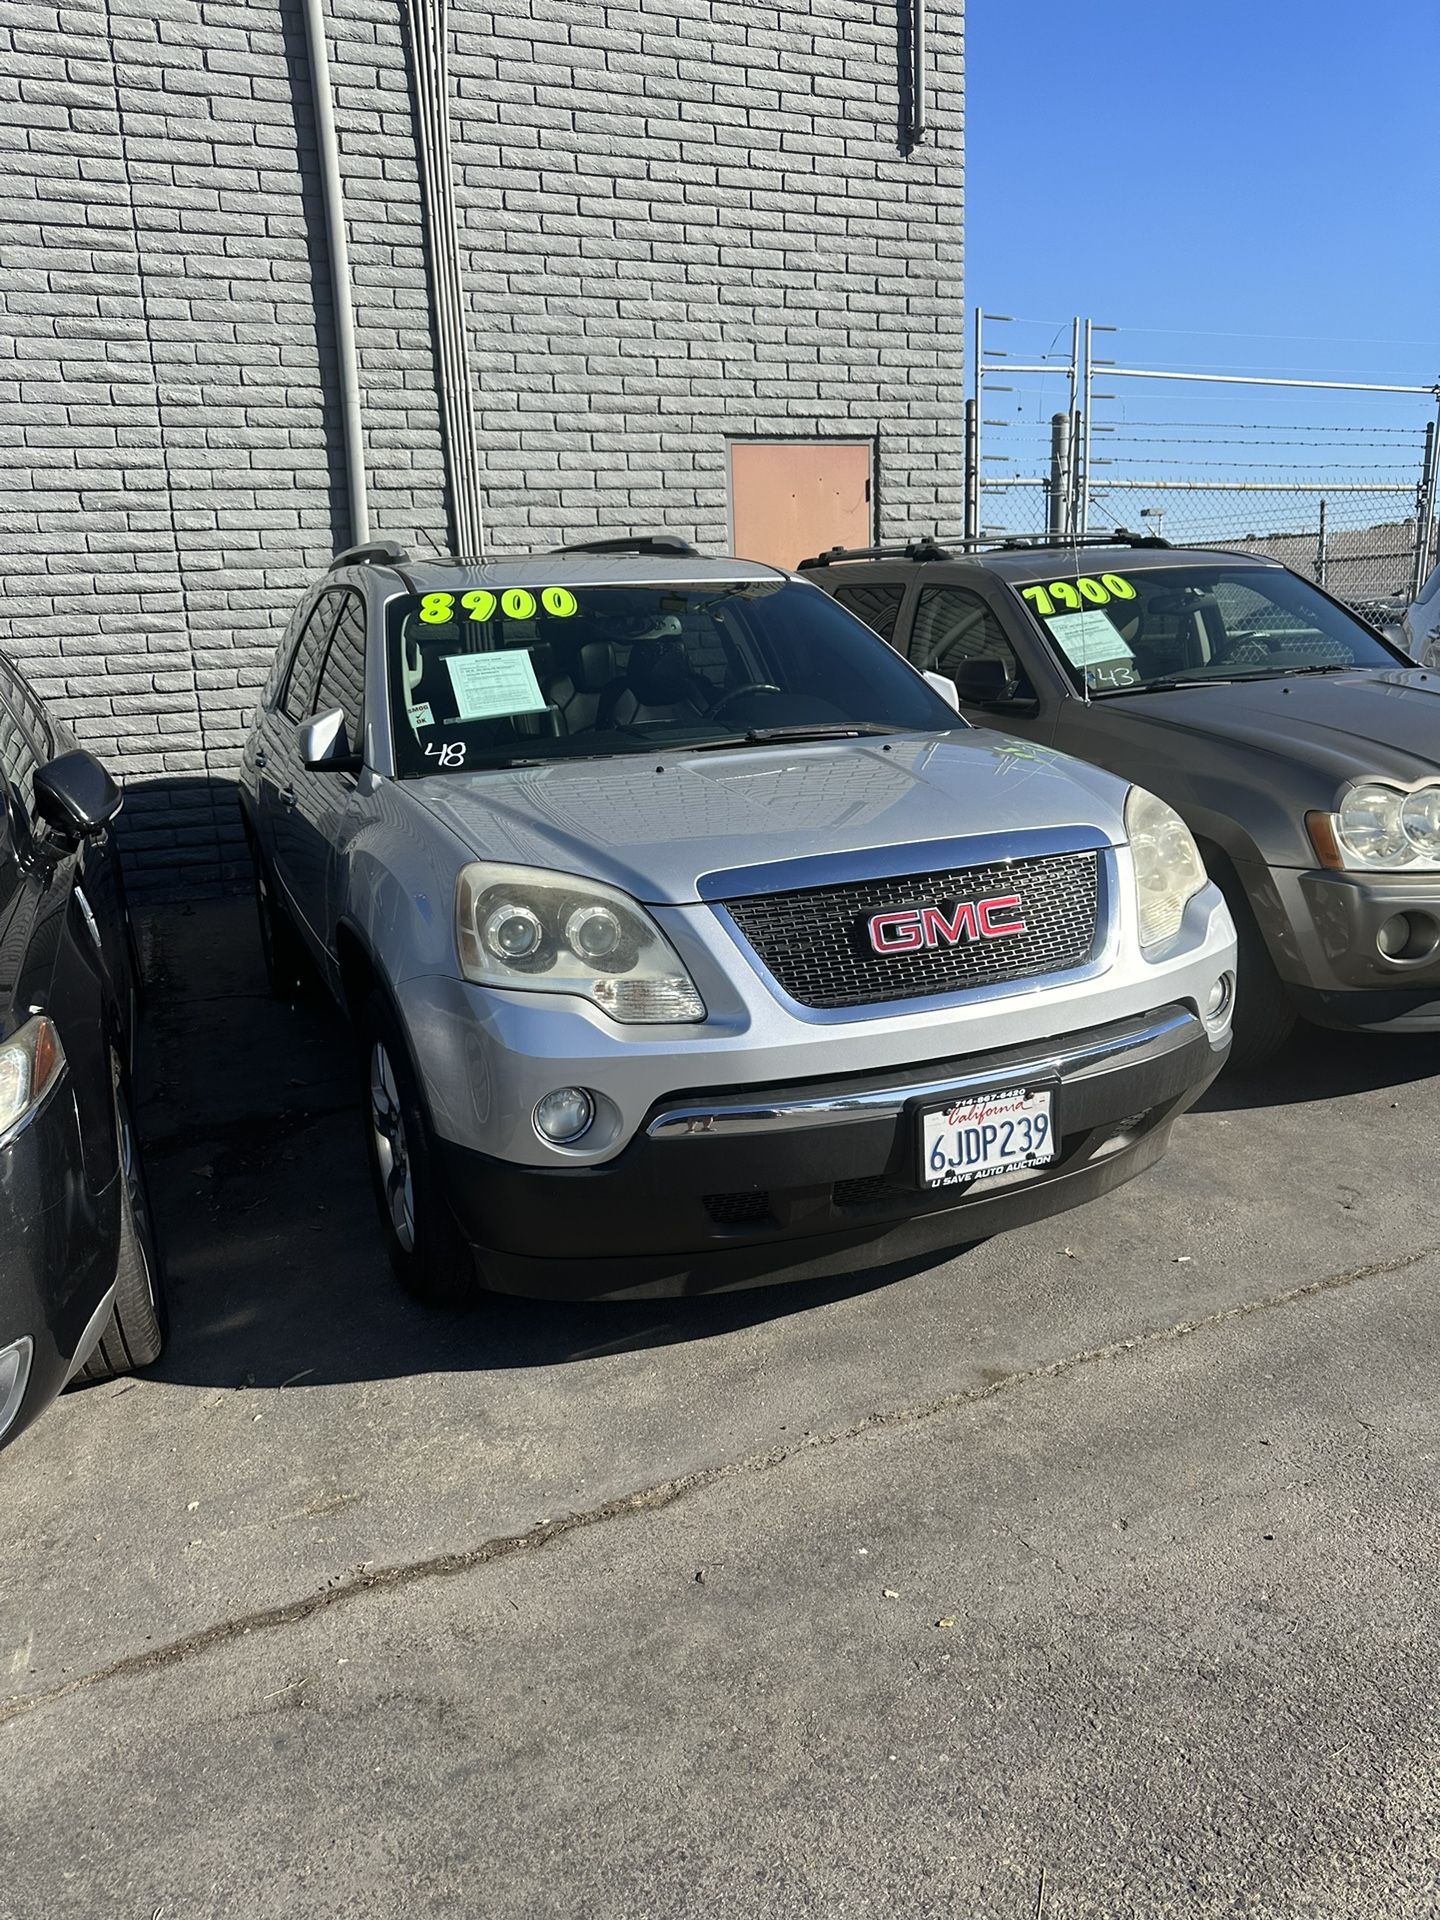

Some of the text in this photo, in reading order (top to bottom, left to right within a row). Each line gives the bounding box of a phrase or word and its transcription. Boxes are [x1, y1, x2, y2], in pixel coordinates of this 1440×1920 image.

[419, 587, 578, 624] 8900
[1022, 574, 1136, 615] 7900
[1097, 668, 1135, 686] 43
[407, 704, 428, 714] SMOG
[424, 742, 466, 767] 48
[870, 894, 1027, 953] GMC
[948, 1098, 1032, 1126] California
[930, 1113, 1049, 1171] 6JDP239
[931, 1155, 1051, 1188] U SAVE AUTO AUCTION
